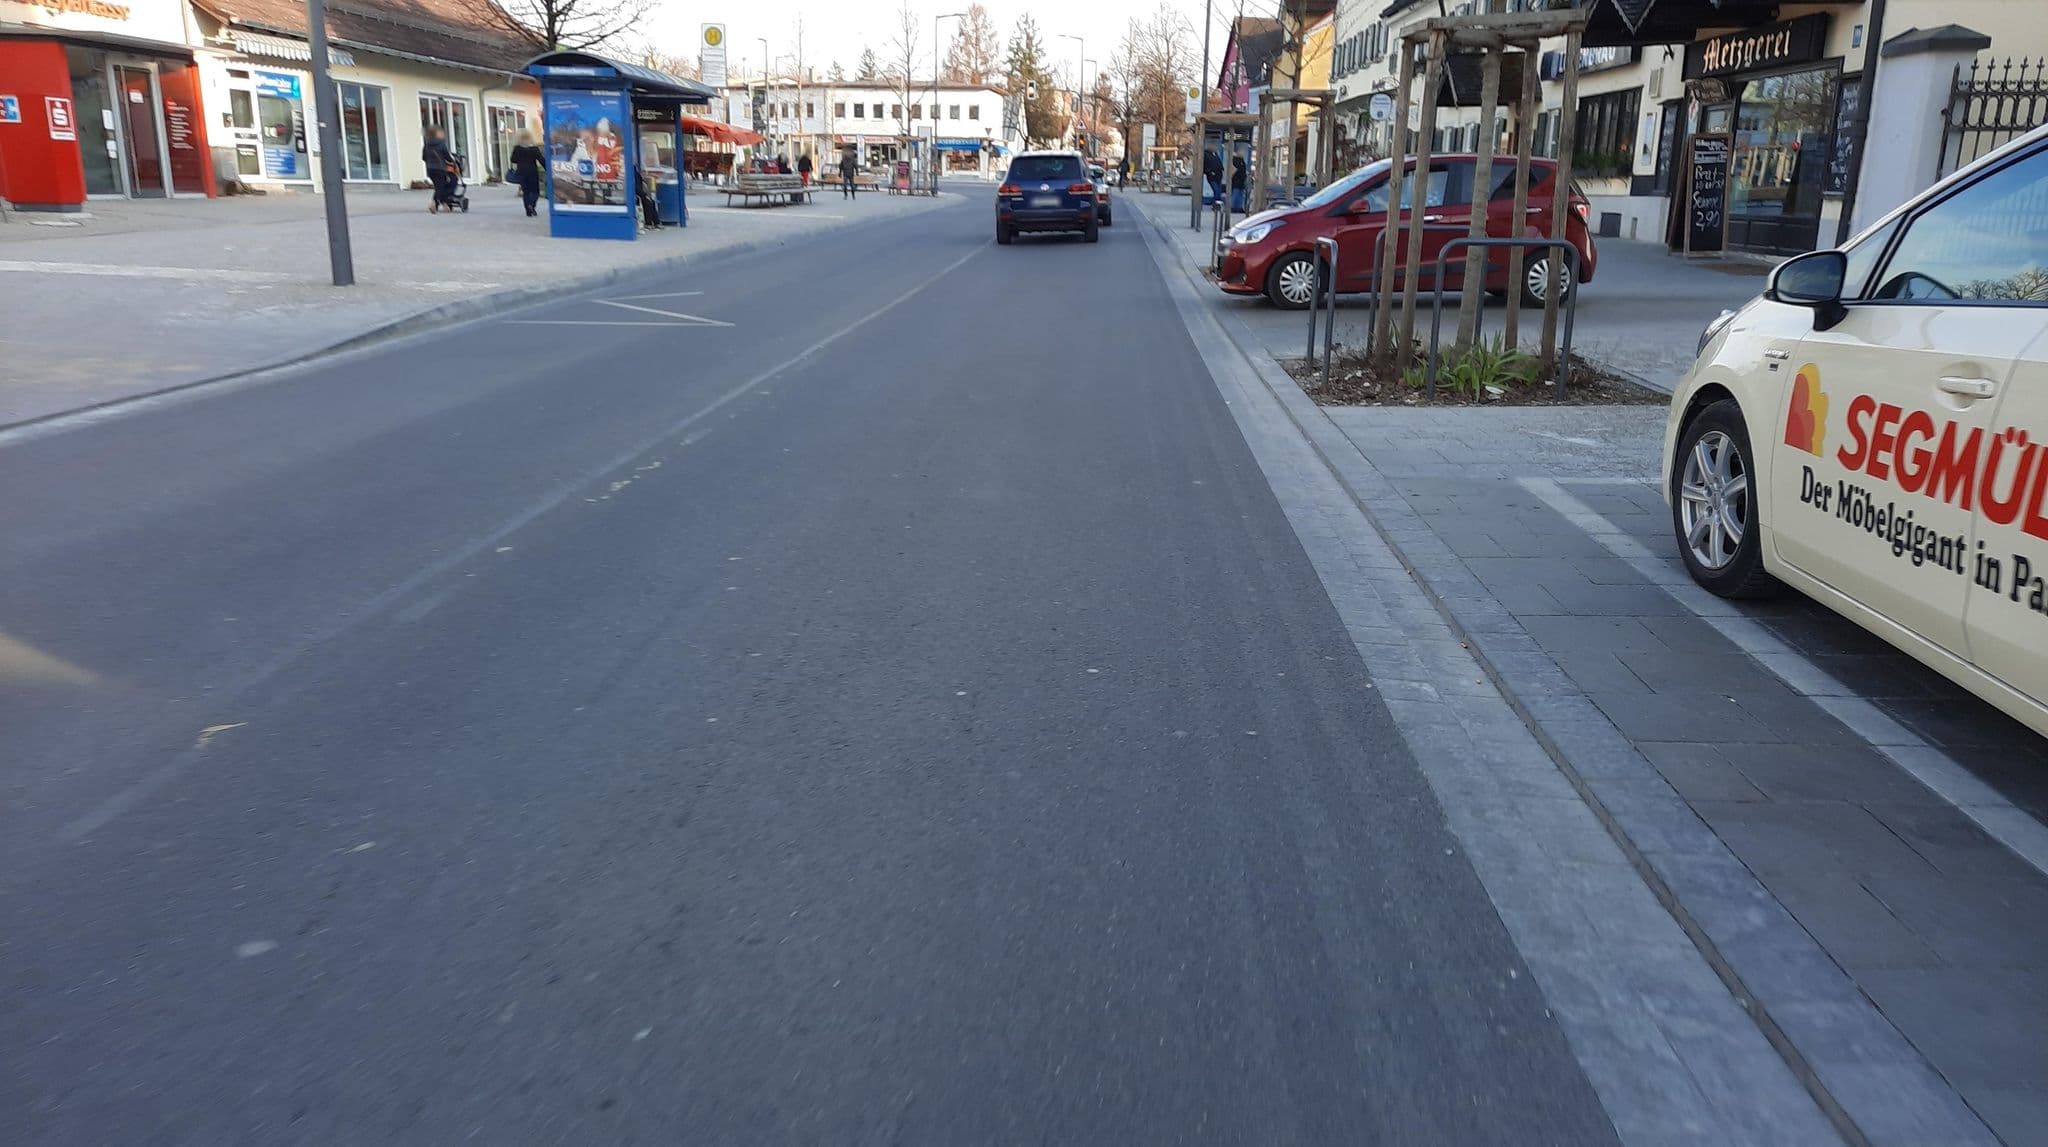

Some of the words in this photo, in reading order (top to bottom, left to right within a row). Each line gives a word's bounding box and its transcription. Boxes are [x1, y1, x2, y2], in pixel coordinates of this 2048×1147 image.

[1702, 21, 1793, 74] Metzgerei
[1800, 465, 1832, 513] Der
[1836, 480, 1966, 576] Möbelgigant
[1974, 540, 2001, 594] in
[2010, 553, 2048, 617] Pa
[1836, 394, 2048, 542] SEGMÜL
